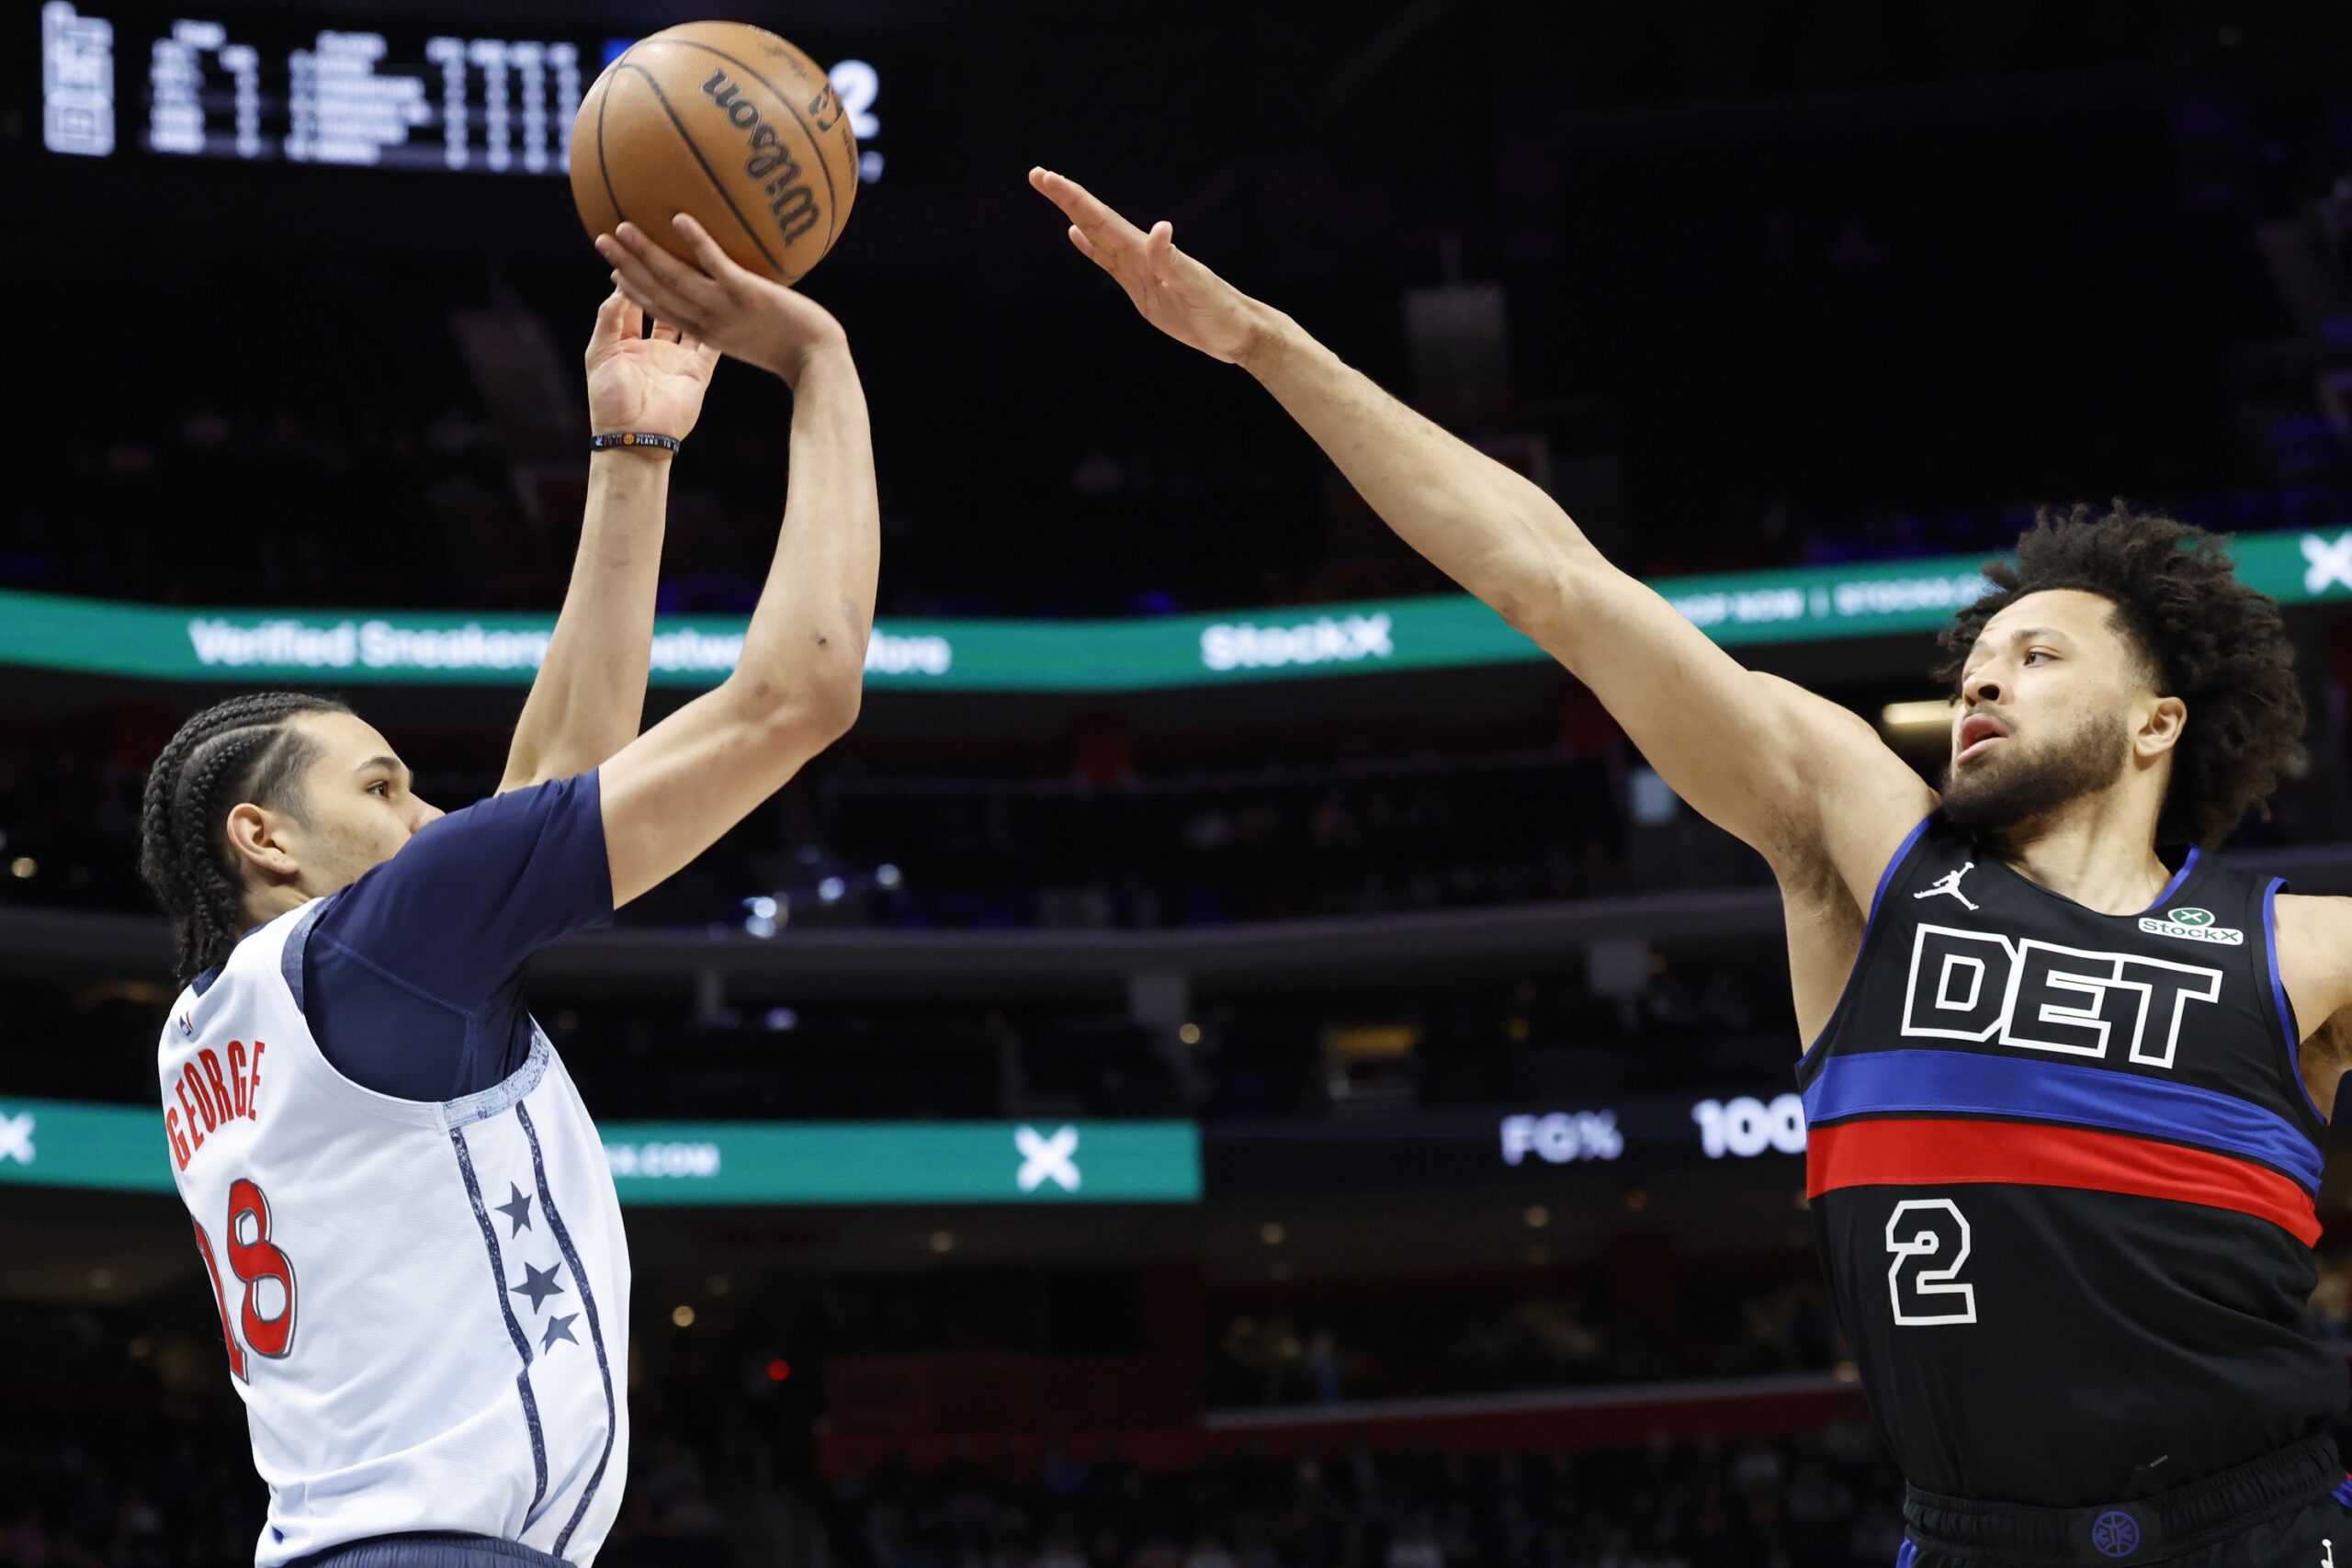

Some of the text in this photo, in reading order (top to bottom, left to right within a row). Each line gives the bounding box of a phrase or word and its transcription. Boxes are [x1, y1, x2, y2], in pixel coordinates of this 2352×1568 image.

[700, 68, 820, 248] Wilson
[188, 618, 356, 668] Verified
[1200, 613, 1394, 671] StockX
[2143, 920, 2238, 942] StockX
[1900, 922, 2223, 1069] DET
[166, 1040, 266, 1172] GEORGE
[1500, 1110, 1623, 1166] FG%
[191, 1179, 298, 1385] 18
[1885, 1198, 1977, 1325] 2
